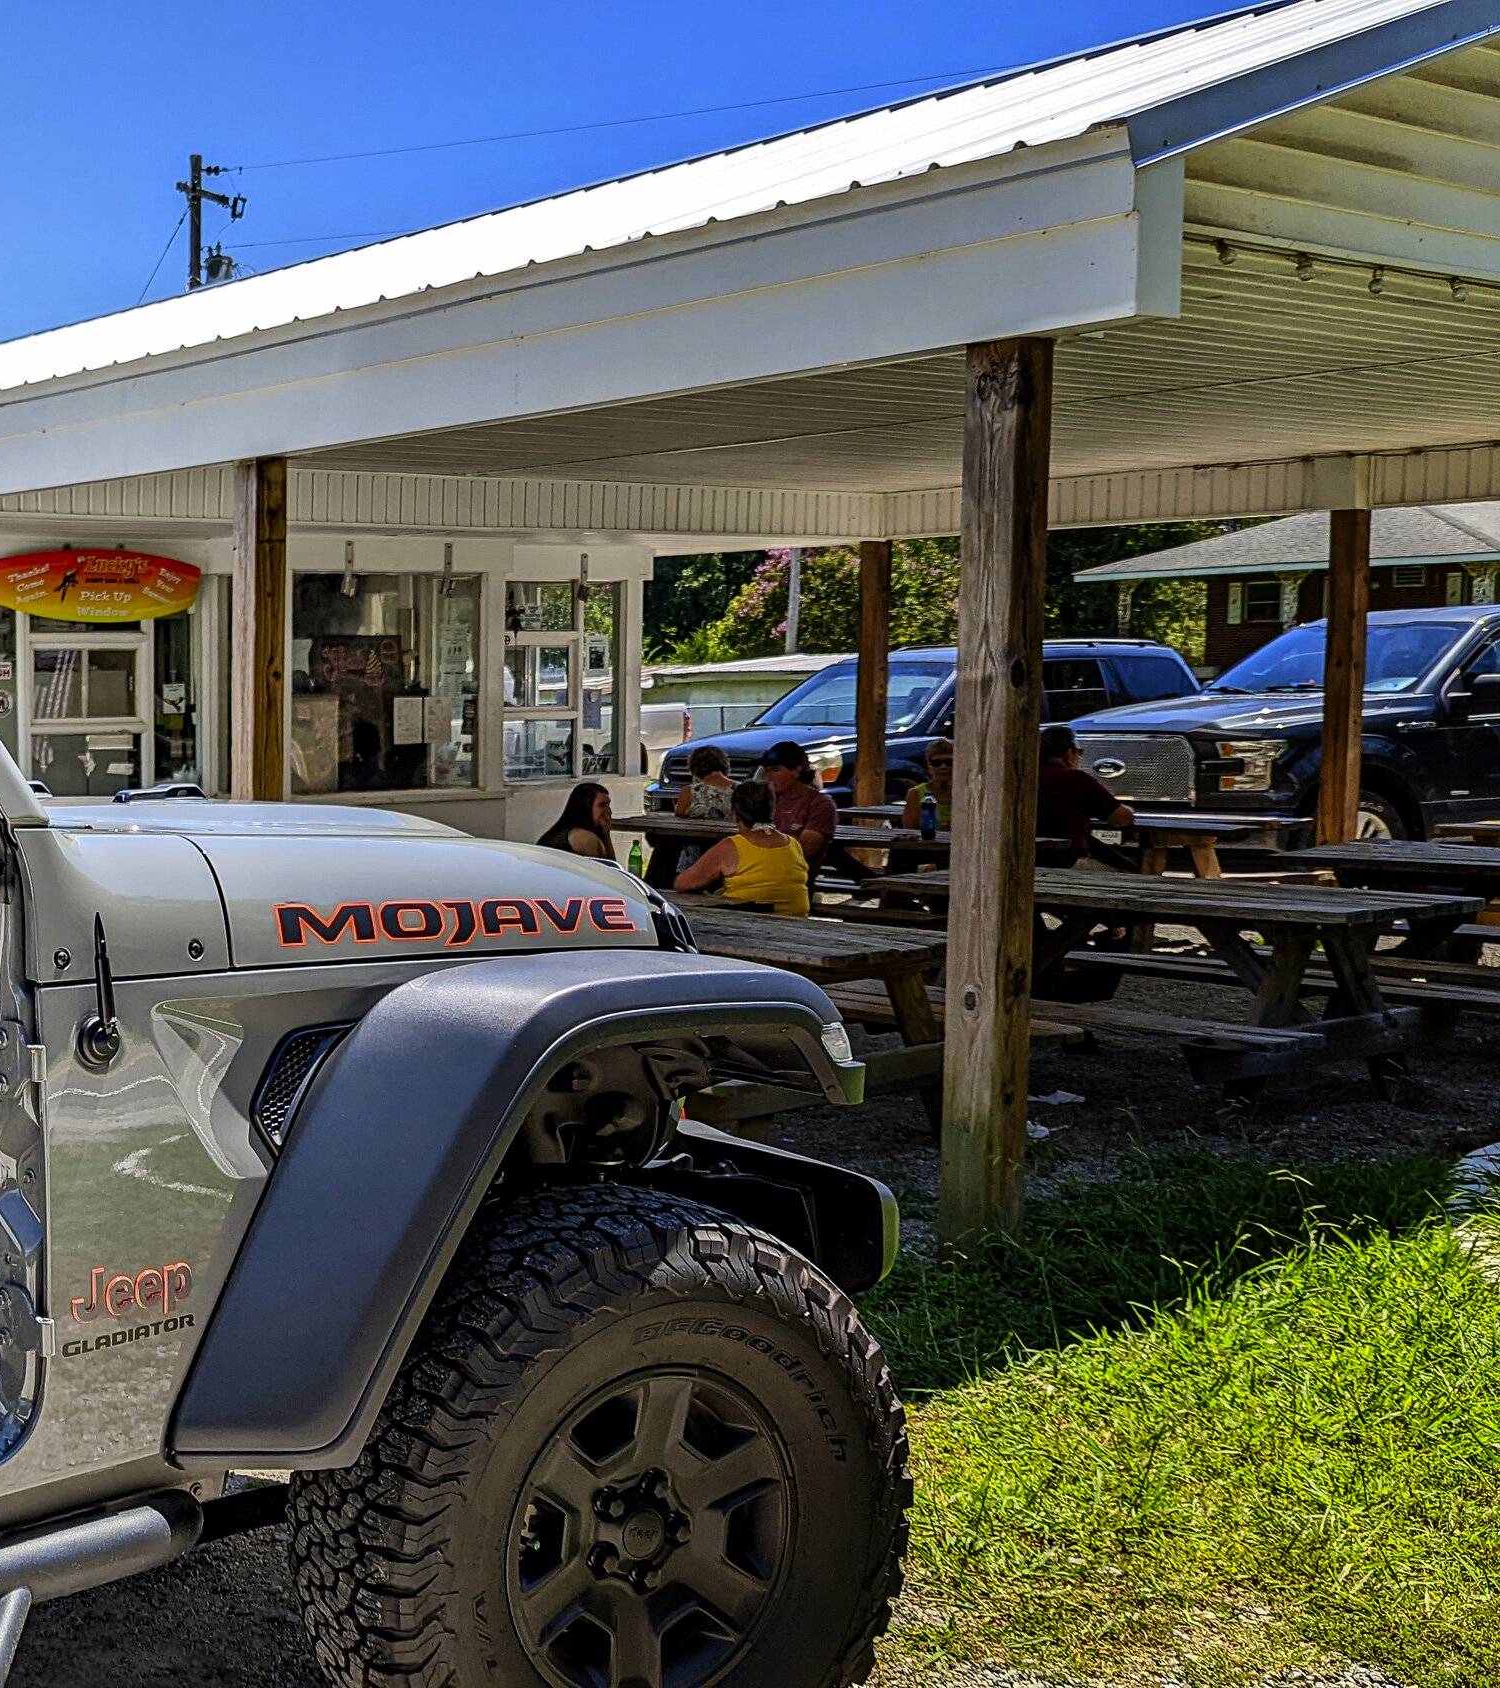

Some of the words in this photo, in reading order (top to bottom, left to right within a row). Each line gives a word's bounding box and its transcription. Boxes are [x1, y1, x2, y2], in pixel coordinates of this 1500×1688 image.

[16, 579, 45, 592] Come
[79, 591, 111, 601] Pick
[113, 591, 132, 603] Up
[77, 606, 130, 617] Window
[274, 898, 636, 947] MOJAVE
[70, 1261, 194, 1325] Jeep
[62, 1312, 196, 1358] GLADIATOR
[631, 1316, 849, 1463] BFGoodrich
